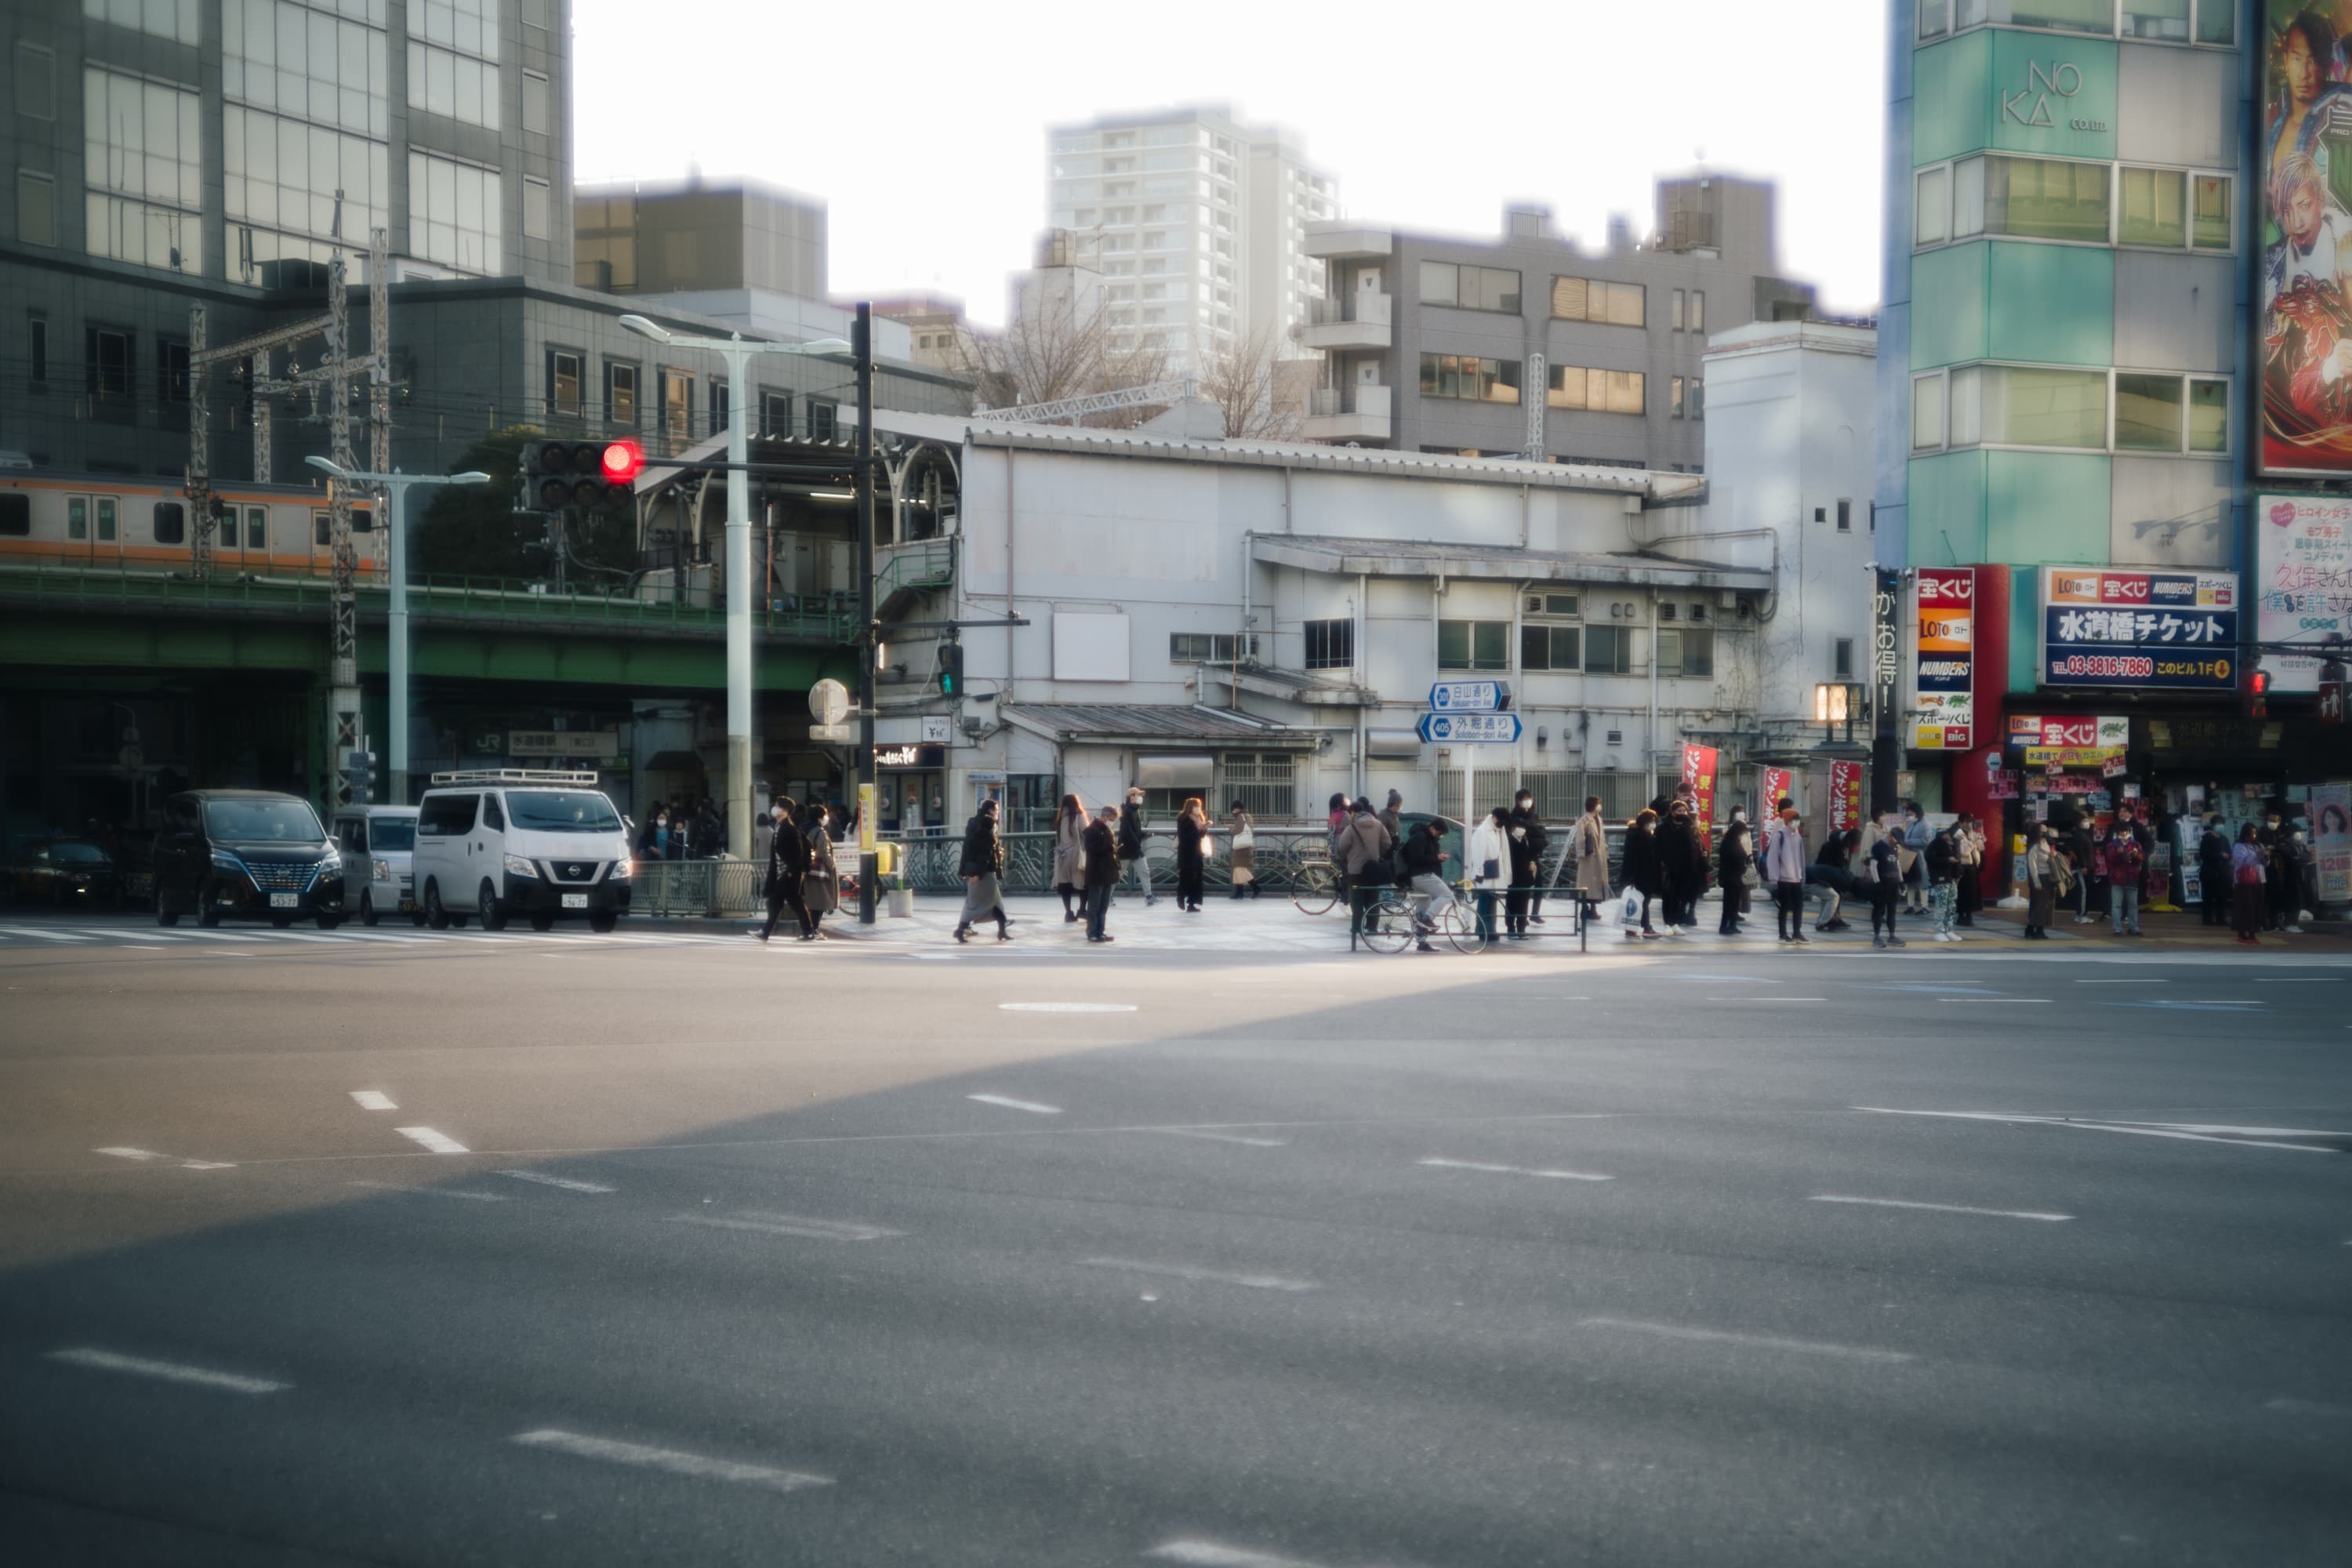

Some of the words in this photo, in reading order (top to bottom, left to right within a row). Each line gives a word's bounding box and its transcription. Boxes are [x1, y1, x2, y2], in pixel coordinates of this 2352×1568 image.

[2029, 57, 2082, 97] NO
[2297, 506, 2351, 519] ヒロイン女子
[1918, 578, 1972, 599] 宝くじ
[2058, 578, 2082, 593] LOTO
[2103, 579, 2148, 598] 宝くじ
[2153, 581, 2195, 596] NUMBERS
[1919, 619, 1951, 638] LOTO
[2059, 610, 2225, 642] 水道橋チケット
[1918, 661, 1970, 677] NUMBERS
[2067, 655, 2154, 677] 03-3816-7860
[1437, 691, 1450, 702] 301
[1454, 684, 1492, 698] 白山通り
[1435, 721, 1450, 733] 405
[1457, 717, 1508, 730] 外堀通り
[1455, 730, 1496, 739] Sotobori-dori
[1497, 730, 1511, 739] Ave.
[2044, 723, 2095, 746] 宝くじ
